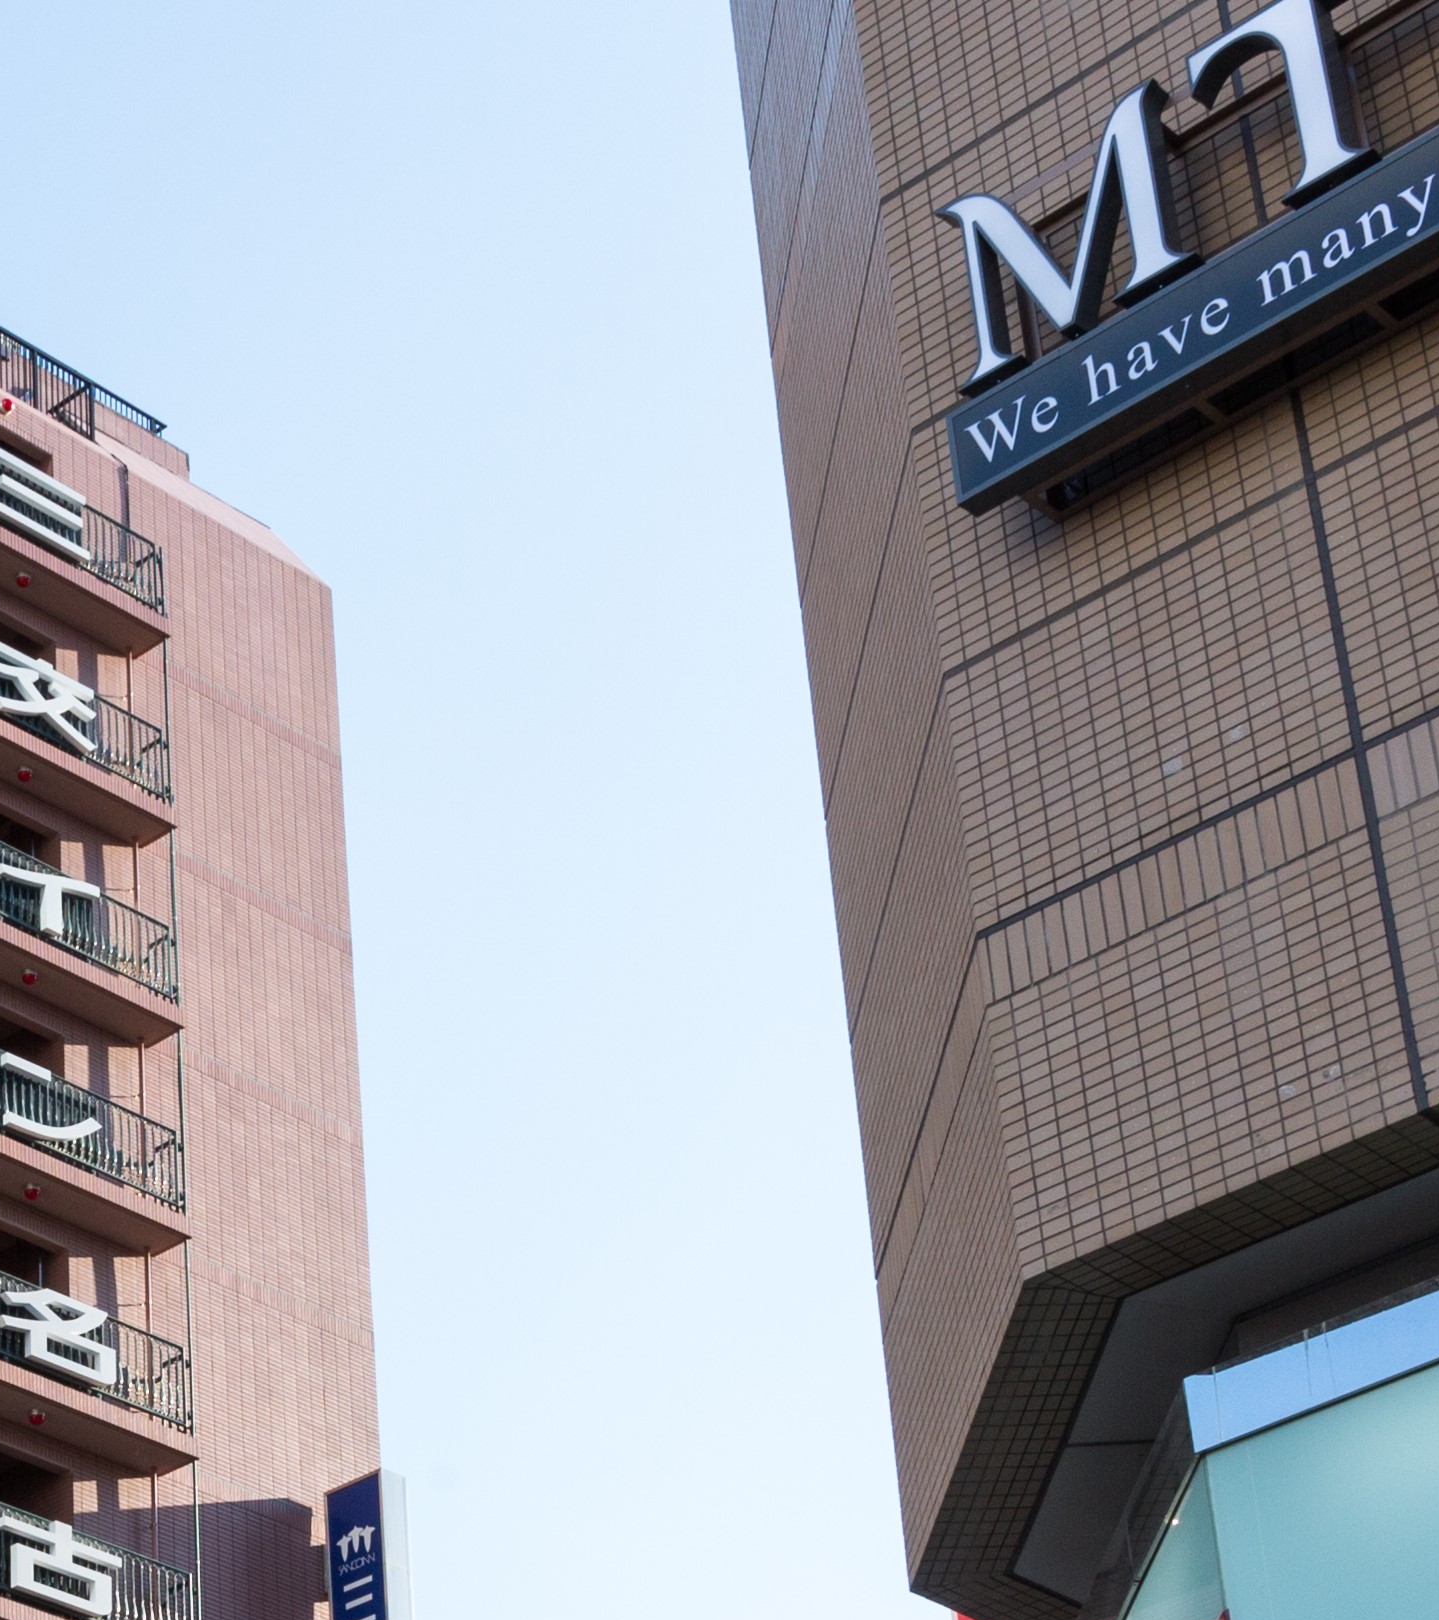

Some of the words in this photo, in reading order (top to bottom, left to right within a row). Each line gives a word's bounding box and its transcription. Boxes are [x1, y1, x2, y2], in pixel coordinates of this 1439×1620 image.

[964, 394, 1059, 463] We
[1083, 296, 1231, 408] have
[1256, 172, 1439, 308] many
